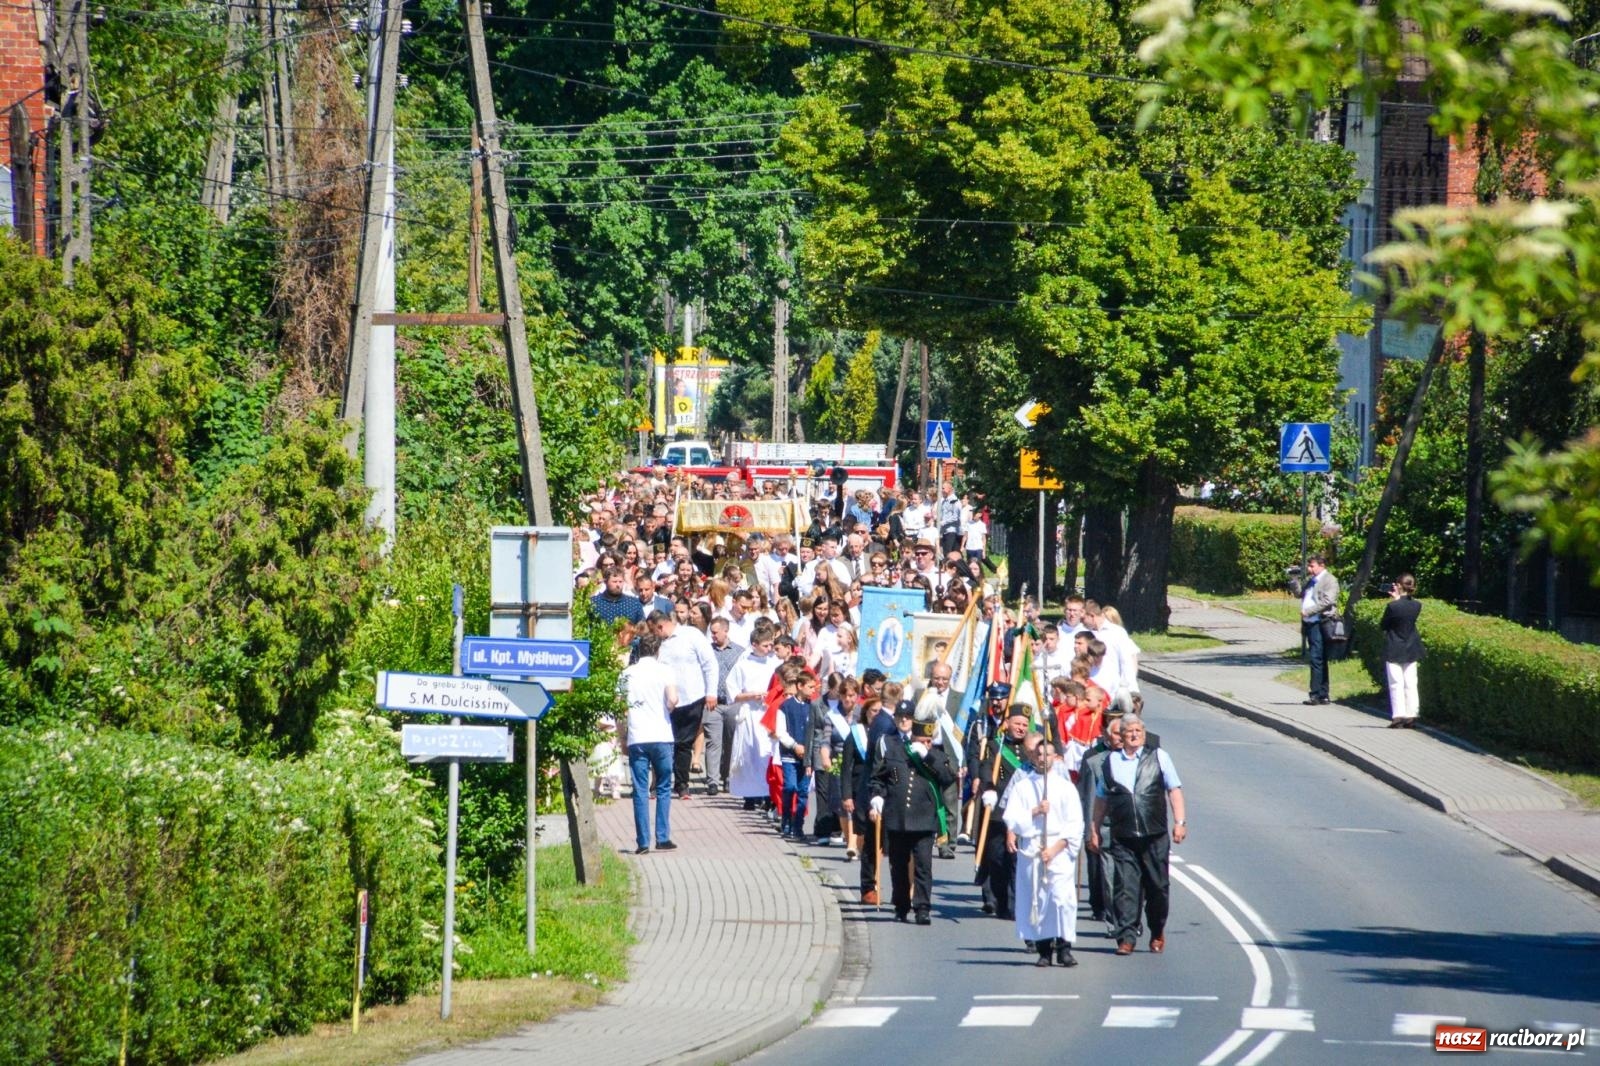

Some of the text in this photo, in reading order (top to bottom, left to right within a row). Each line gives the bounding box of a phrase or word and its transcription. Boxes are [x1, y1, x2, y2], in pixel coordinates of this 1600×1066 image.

[473, 649, 573, 667] ul. Kpt. Myśliwca
[417, 678, 428, 686] Do
[433, 680, 457, 690] grobu
[441, 694, 511, 714] Dulcissimy
